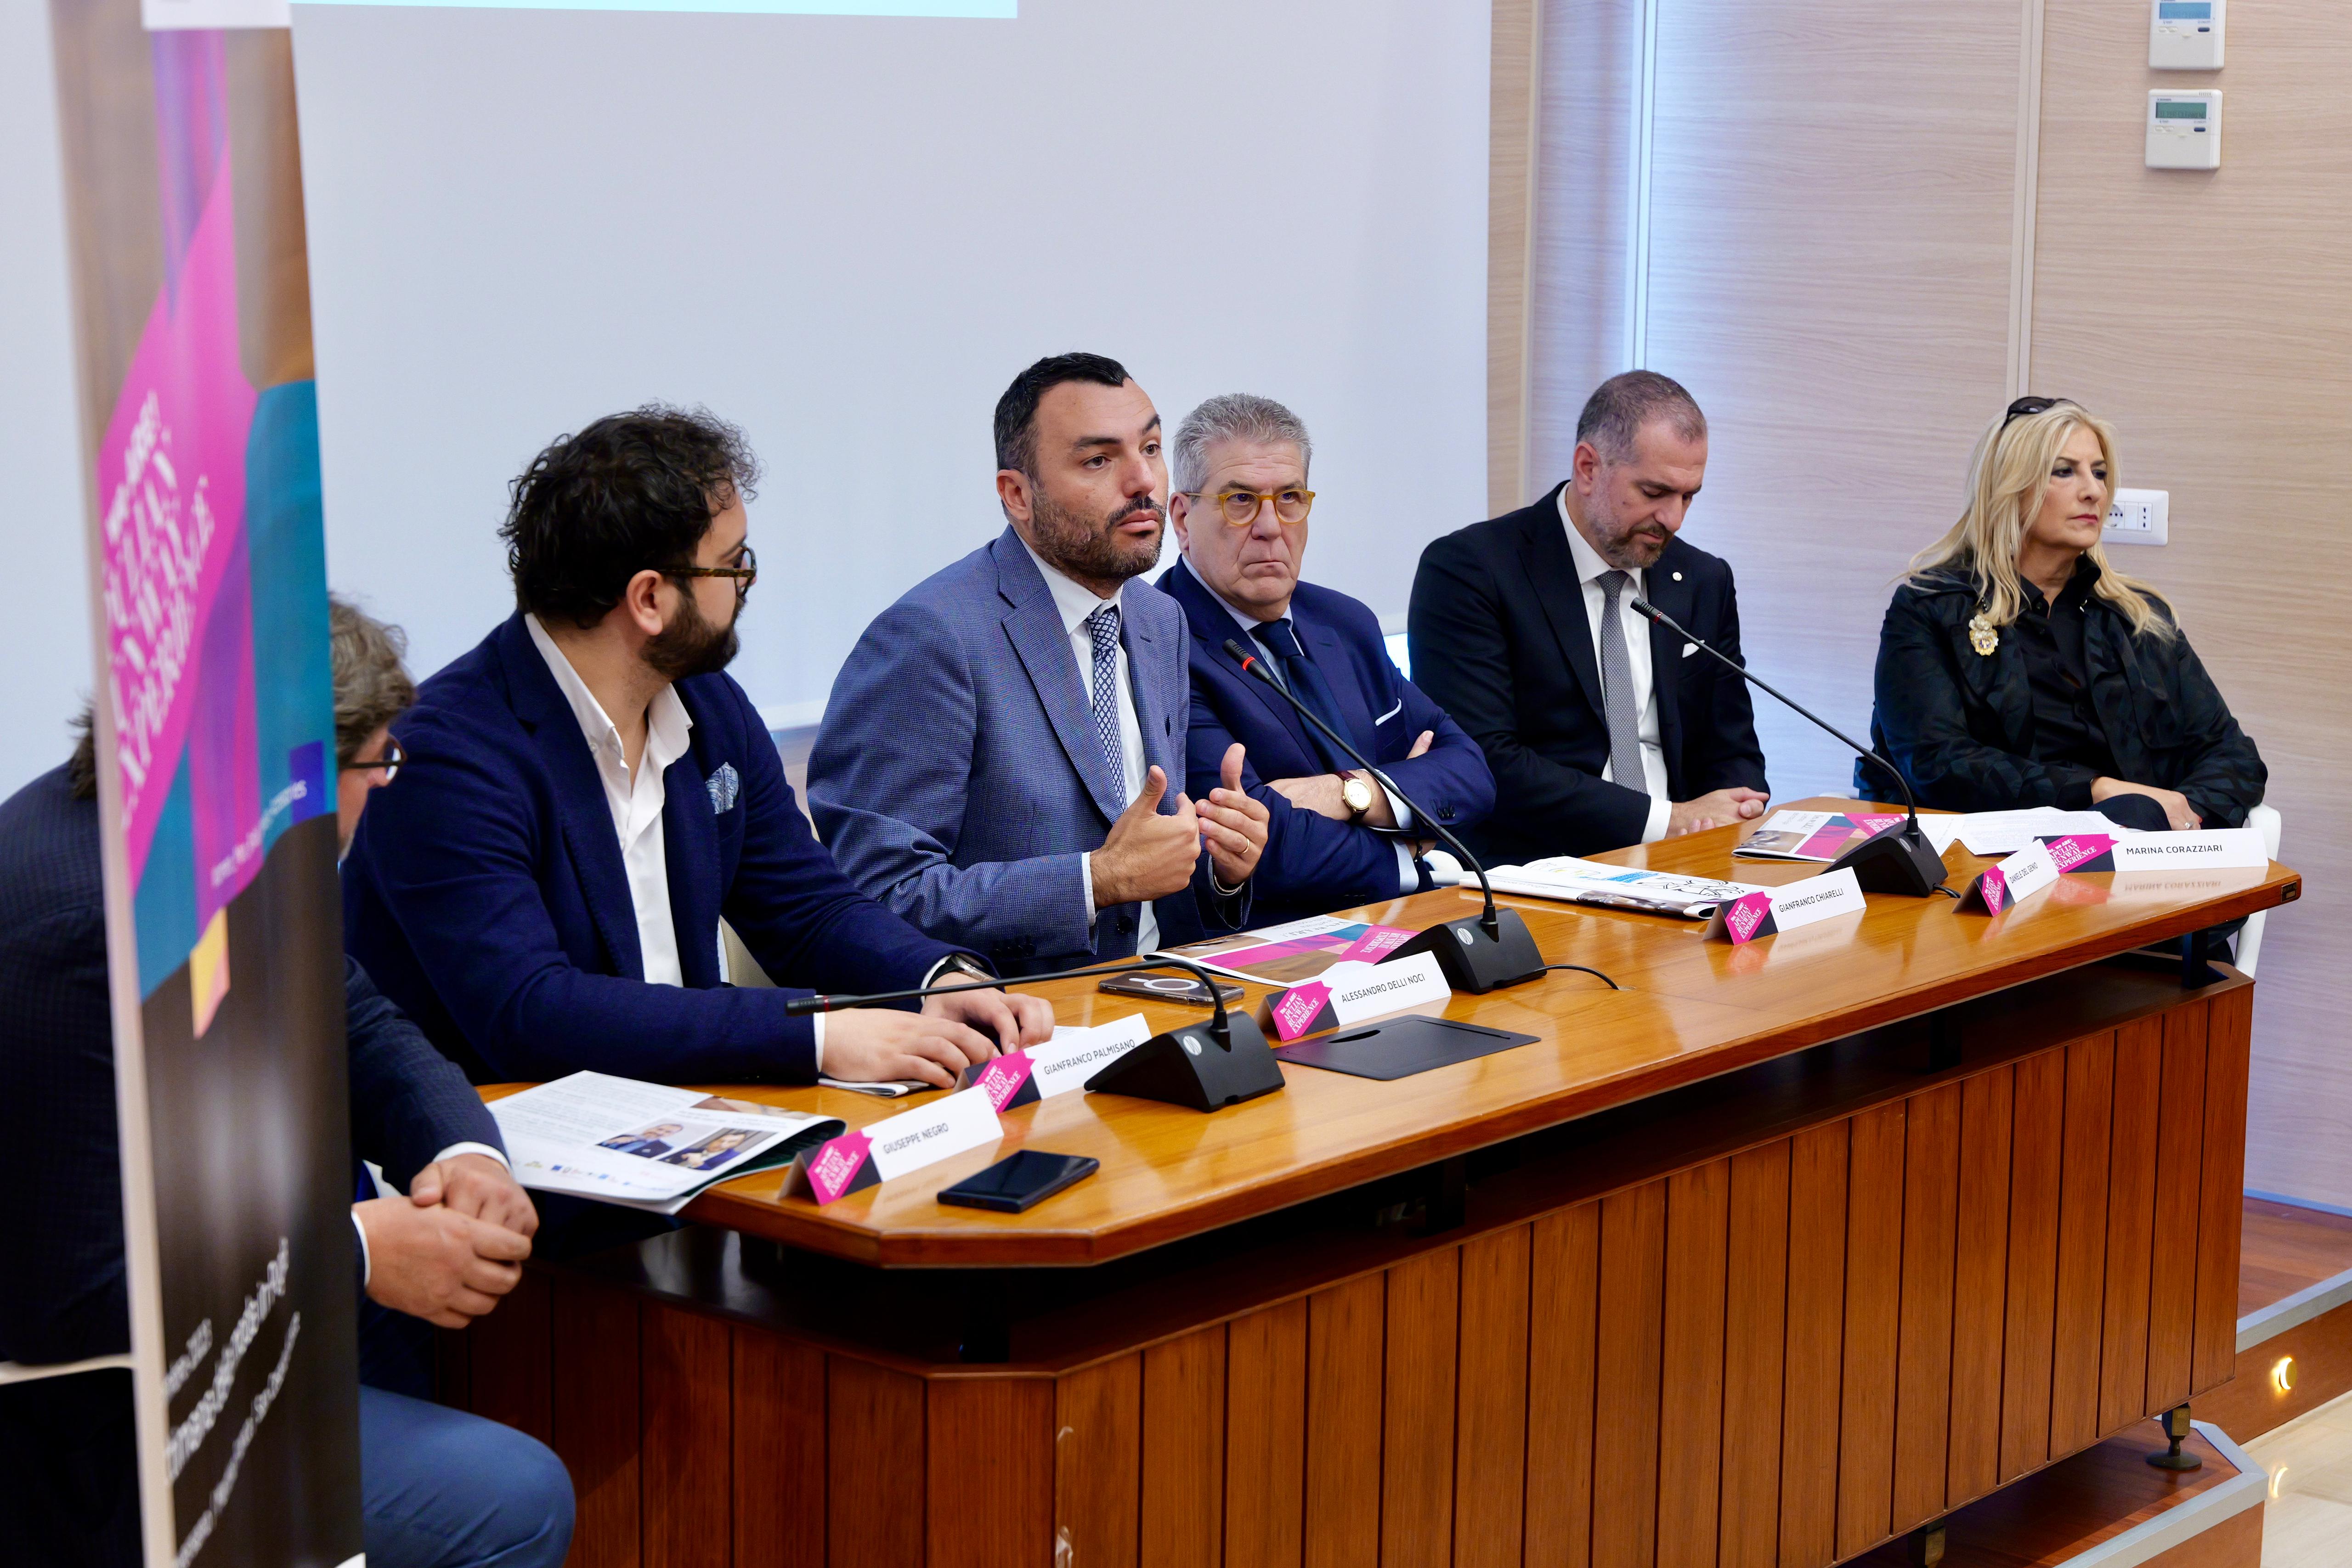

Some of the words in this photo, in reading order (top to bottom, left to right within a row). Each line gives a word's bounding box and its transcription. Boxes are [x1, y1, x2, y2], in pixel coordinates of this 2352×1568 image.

[2055, 846, 2097, 871] EXPERIENCE
[2166, 845, 2222, 853] CORAZZIARI
[2009, 871, 2023, 884] DANIELE
[1779, 896, 1815, 913] GIANFRANCO
[1816, 888, 1844, 902] CHIARELLI
[1734, 904, 1749, 928] APULIAN
[1736, 909, 1753, 934] RUNWAY
[1740, 907, 1762, 940] EXPERIENCE
[1341, 984, 1387, 1004] ALESSANDRO
[1388, 979, 1407, 990] DELLI
[1408, 973, 1425, 984] NOCI
[1283, 995, 1303, 1021] APULIAN
[1287, 1001, 1307, 1027] RUNWAY
[1292, 998, 1319, 1034] EXPERIENCE
[1044, 1053, 1093, 1075] GIANFRANCO
[1095, 1039, 1136, 1060] PALMISANO
[882, 1134, 921, 1155] GIUSEPPE
[922, 1122, 950, 1140] NEGRO
